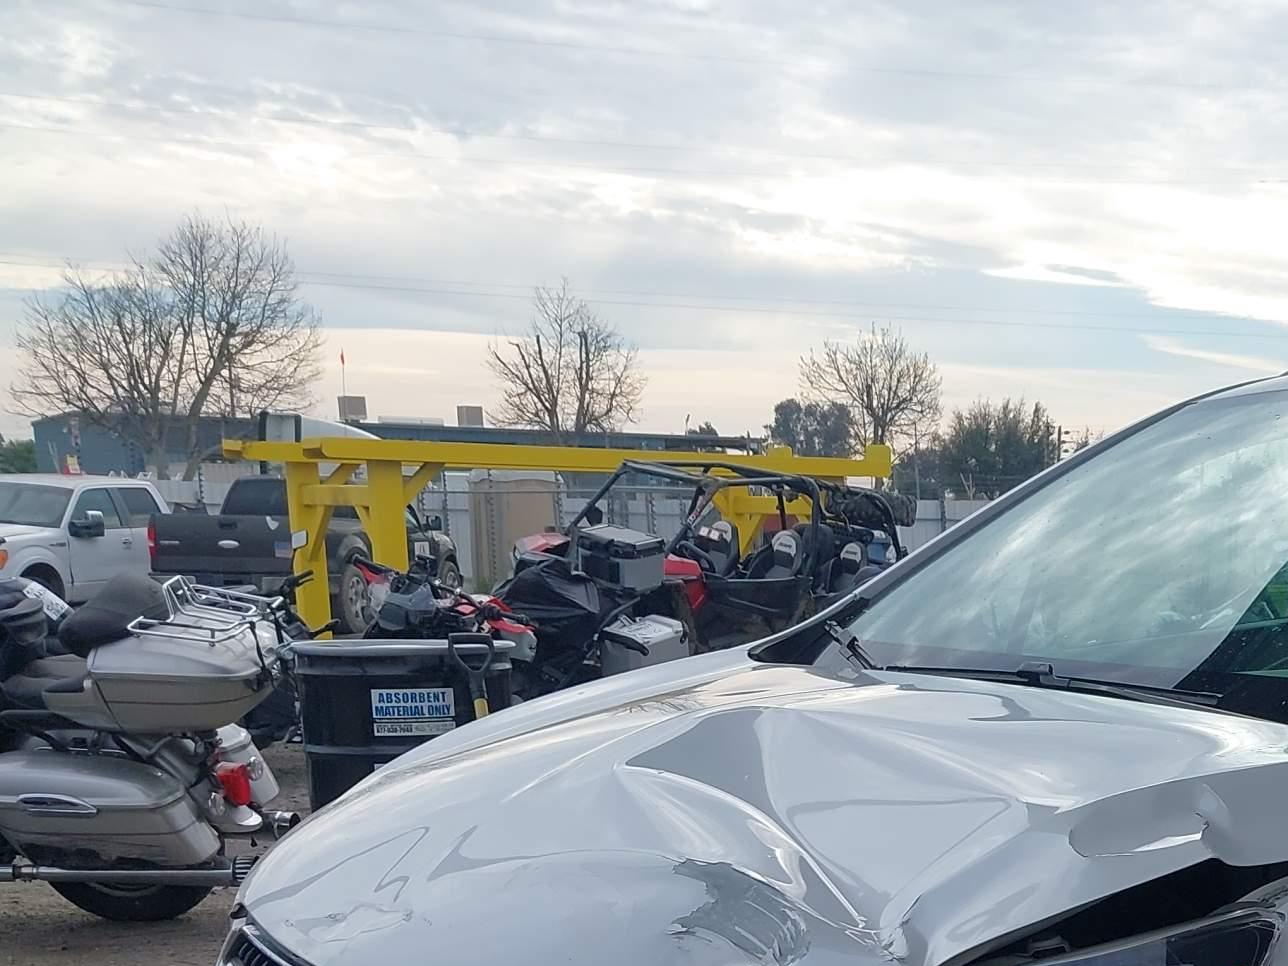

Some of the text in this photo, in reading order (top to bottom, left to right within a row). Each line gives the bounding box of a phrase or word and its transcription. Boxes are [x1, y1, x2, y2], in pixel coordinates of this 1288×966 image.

[378, 692, 447, 704] ABSORBENT
[375, 703, 451, 717] MATERIAL ONLY
